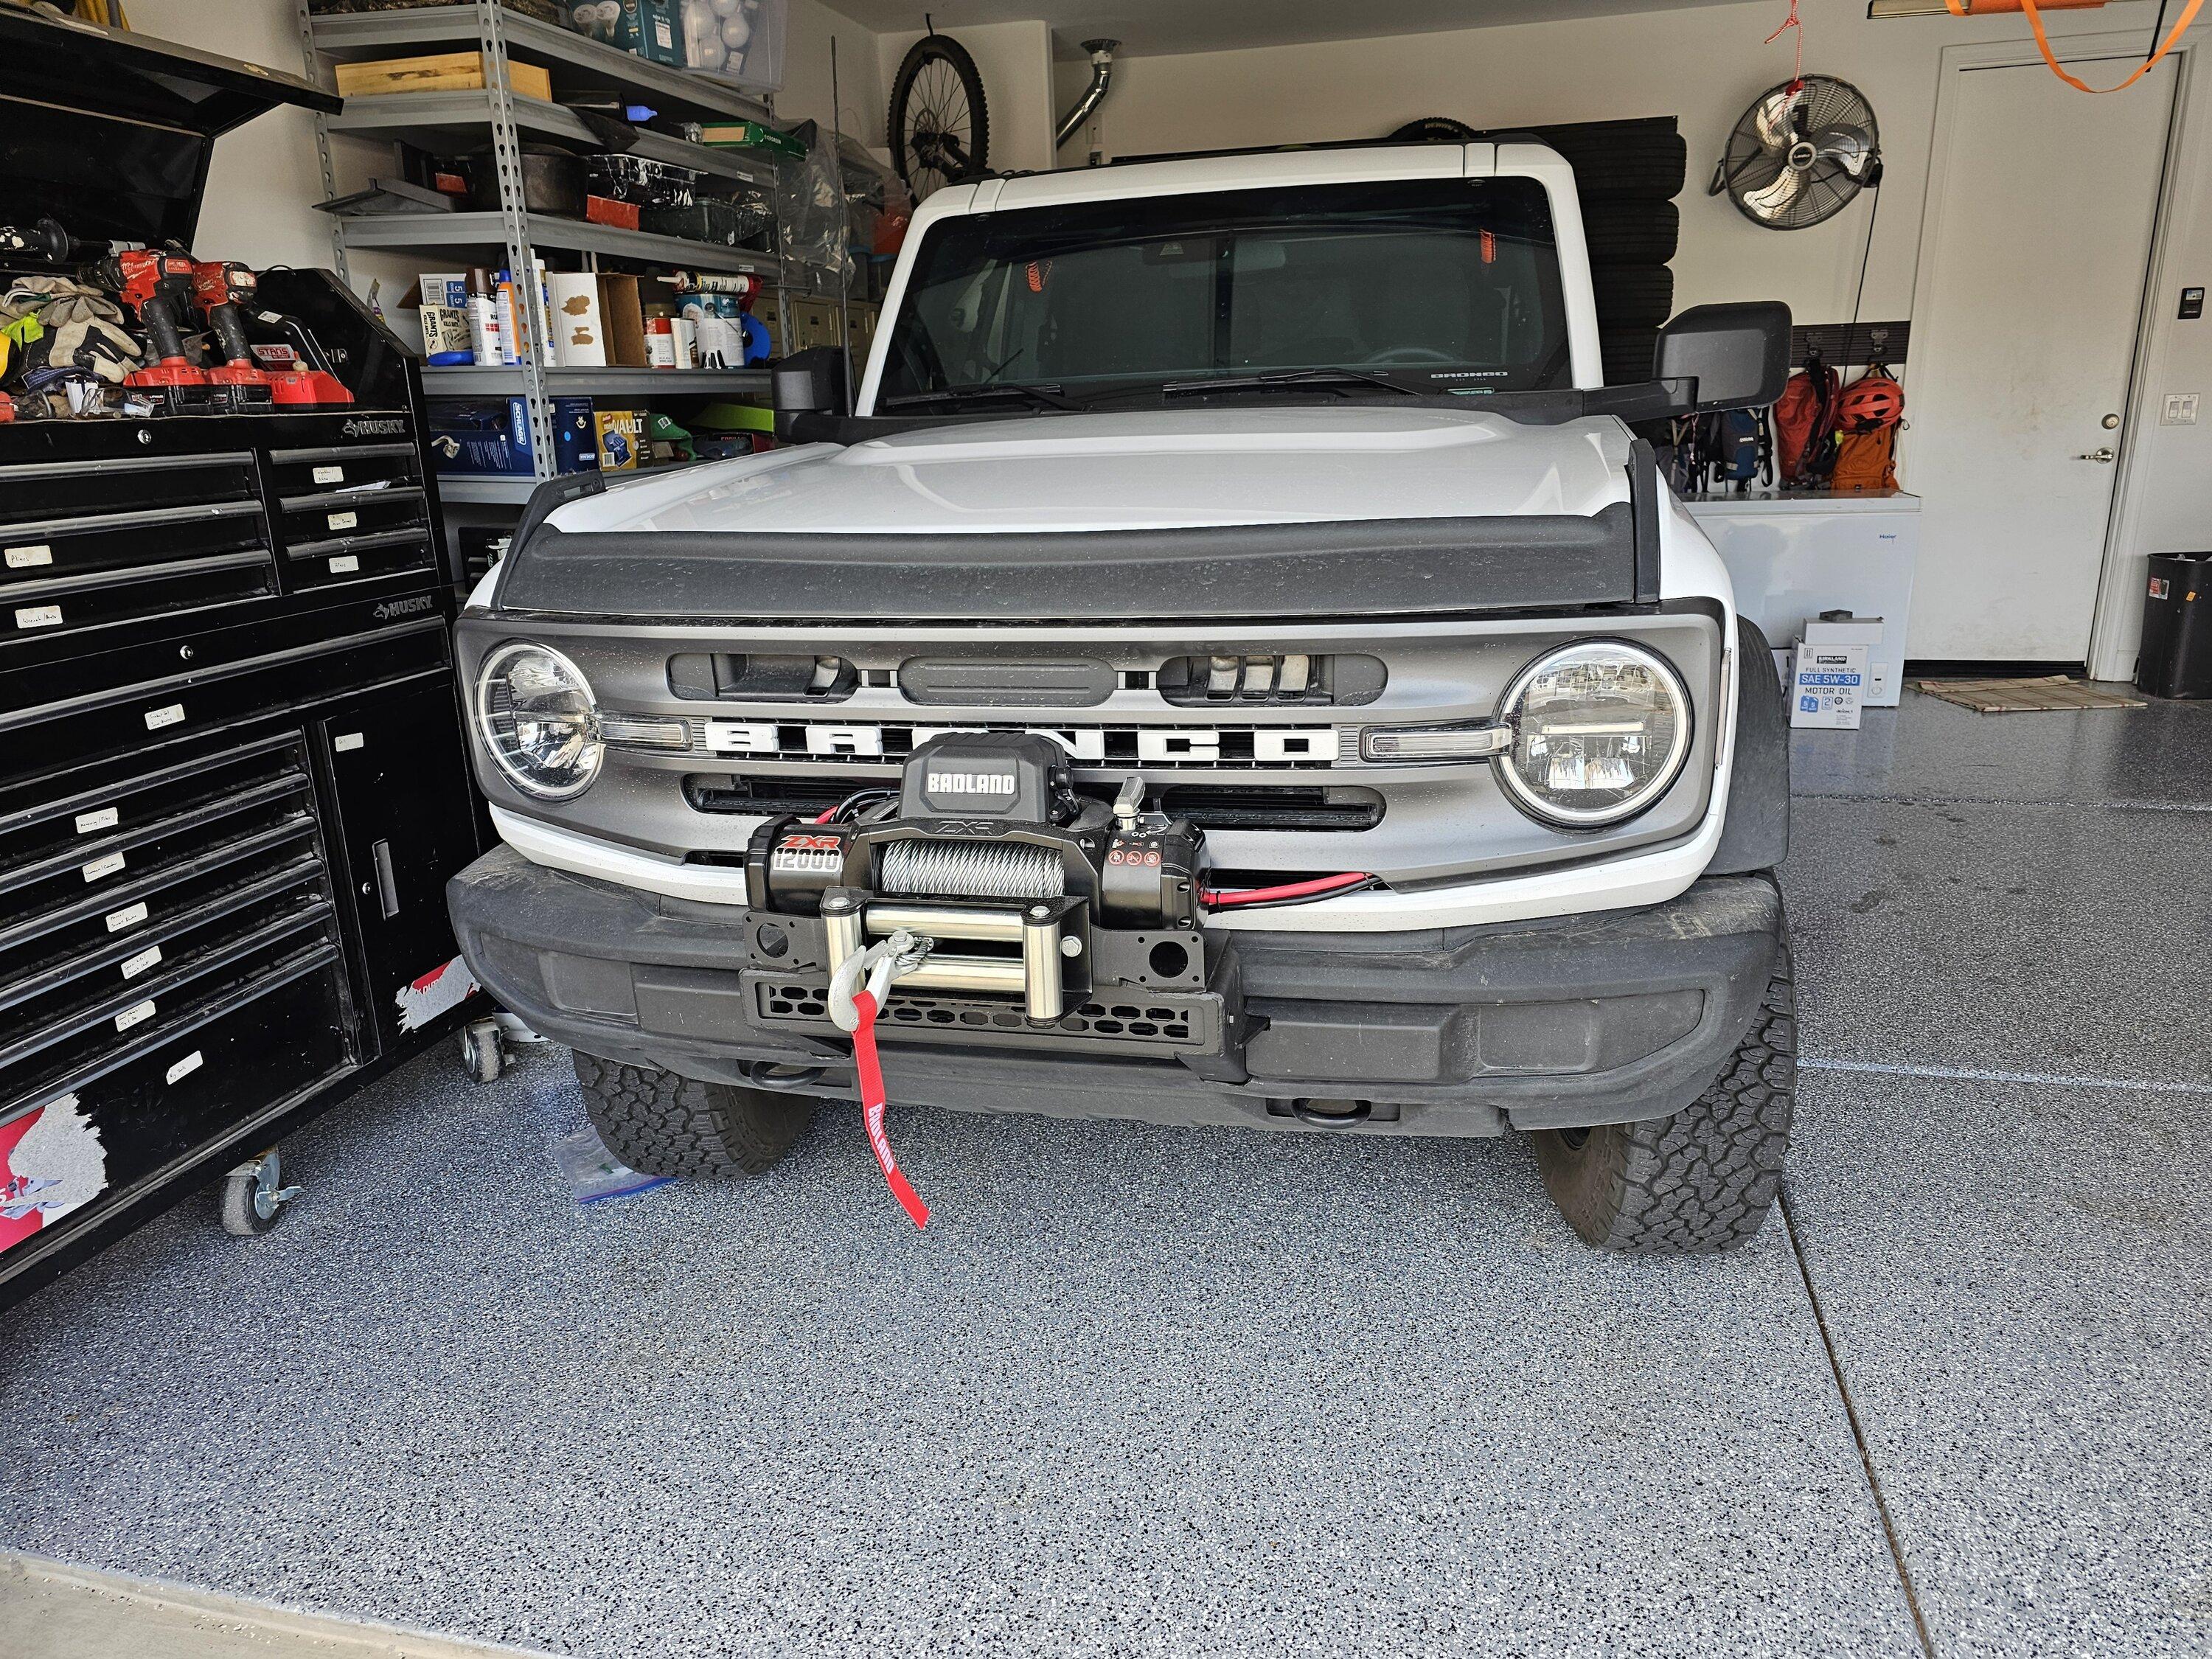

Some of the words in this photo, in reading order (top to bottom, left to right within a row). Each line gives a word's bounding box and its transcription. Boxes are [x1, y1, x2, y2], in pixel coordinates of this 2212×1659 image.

[426, 311, 438, 338] GRANTS
[439, 308, 460, 323] GRANTS
[358, 420, 406, 434] HUSKY
[515, 403, 526, 443] SCHLAGE
[613, 418, 643, 434] VAULT
[388, 595, 433, 616] HUSKY
[1801, 675, 1821, 684] SAE
[1823, 675, 1858, 684] 5W-30
[704, 721, 1339, 761] BRNCO
[928, 773, 1015, 795] BADLAND
[781, 835, 842, 849] ZXR
[774, 848, 842, 870] 12000
[868, 1102, 894, 1175] BADLAND
